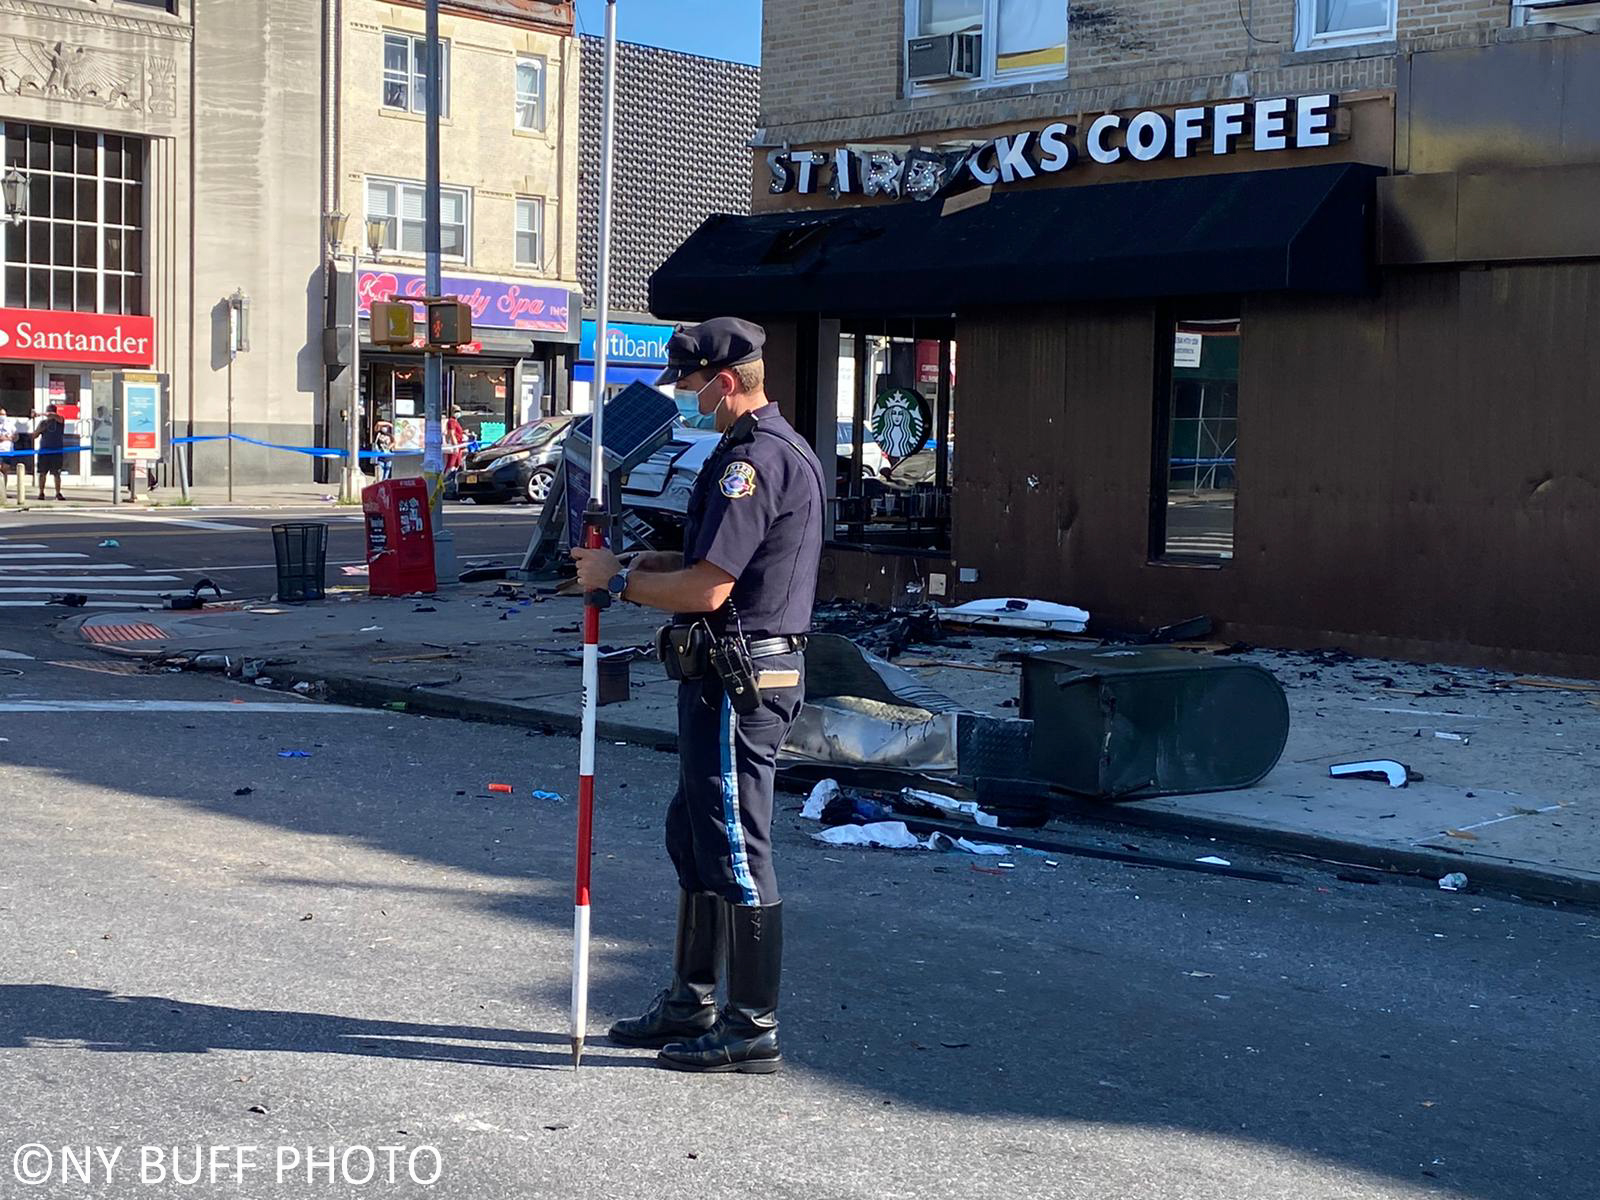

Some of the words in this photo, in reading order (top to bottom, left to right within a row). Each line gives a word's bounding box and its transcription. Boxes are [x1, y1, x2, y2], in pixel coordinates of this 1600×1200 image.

[767, 122, 1074, 201] STARBCKS
[1086, 94, 1331, 165] COFFEE
[406, 278, 491, 318] Buty
[497, 285, 546, 320] Spa
[550, 306, 567, 317] INC
[15, 322, 148, 354] Santander
